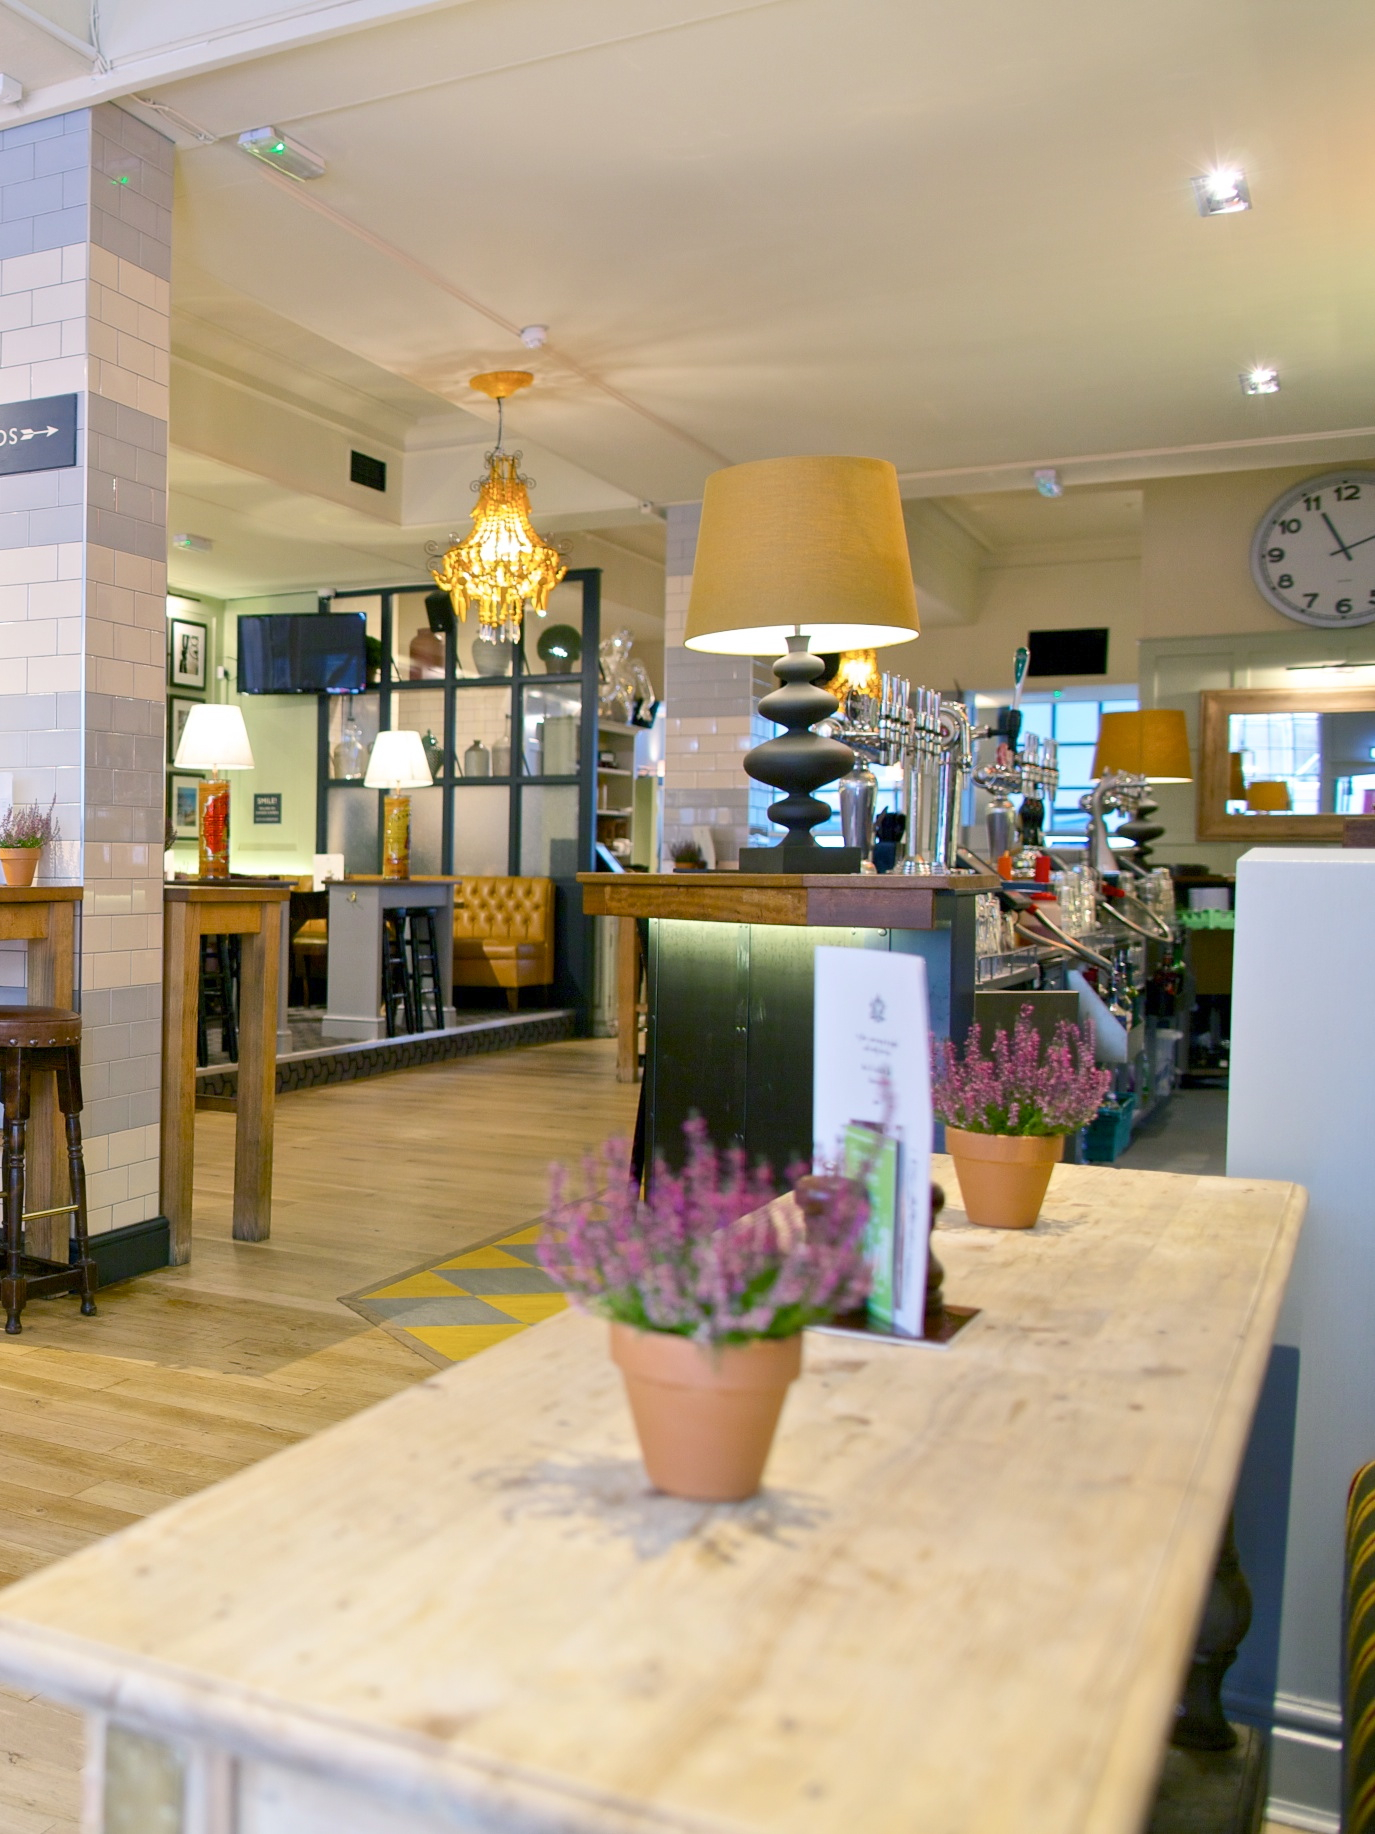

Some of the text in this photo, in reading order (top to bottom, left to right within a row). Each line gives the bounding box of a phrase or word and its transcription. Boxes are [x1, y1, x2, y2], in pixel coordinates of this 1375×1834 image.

[1334, 485, 1361, 501] 12
[1303, 495, 1321, 511] 11
[1278, 518, 1302, 534] 10
[1268, 548, 1285, 563] 9
[1277, 574, 1294, 589] 8
[1303, 593, 1319, 608] 7
[1336, 599, 1353, 614] 6
